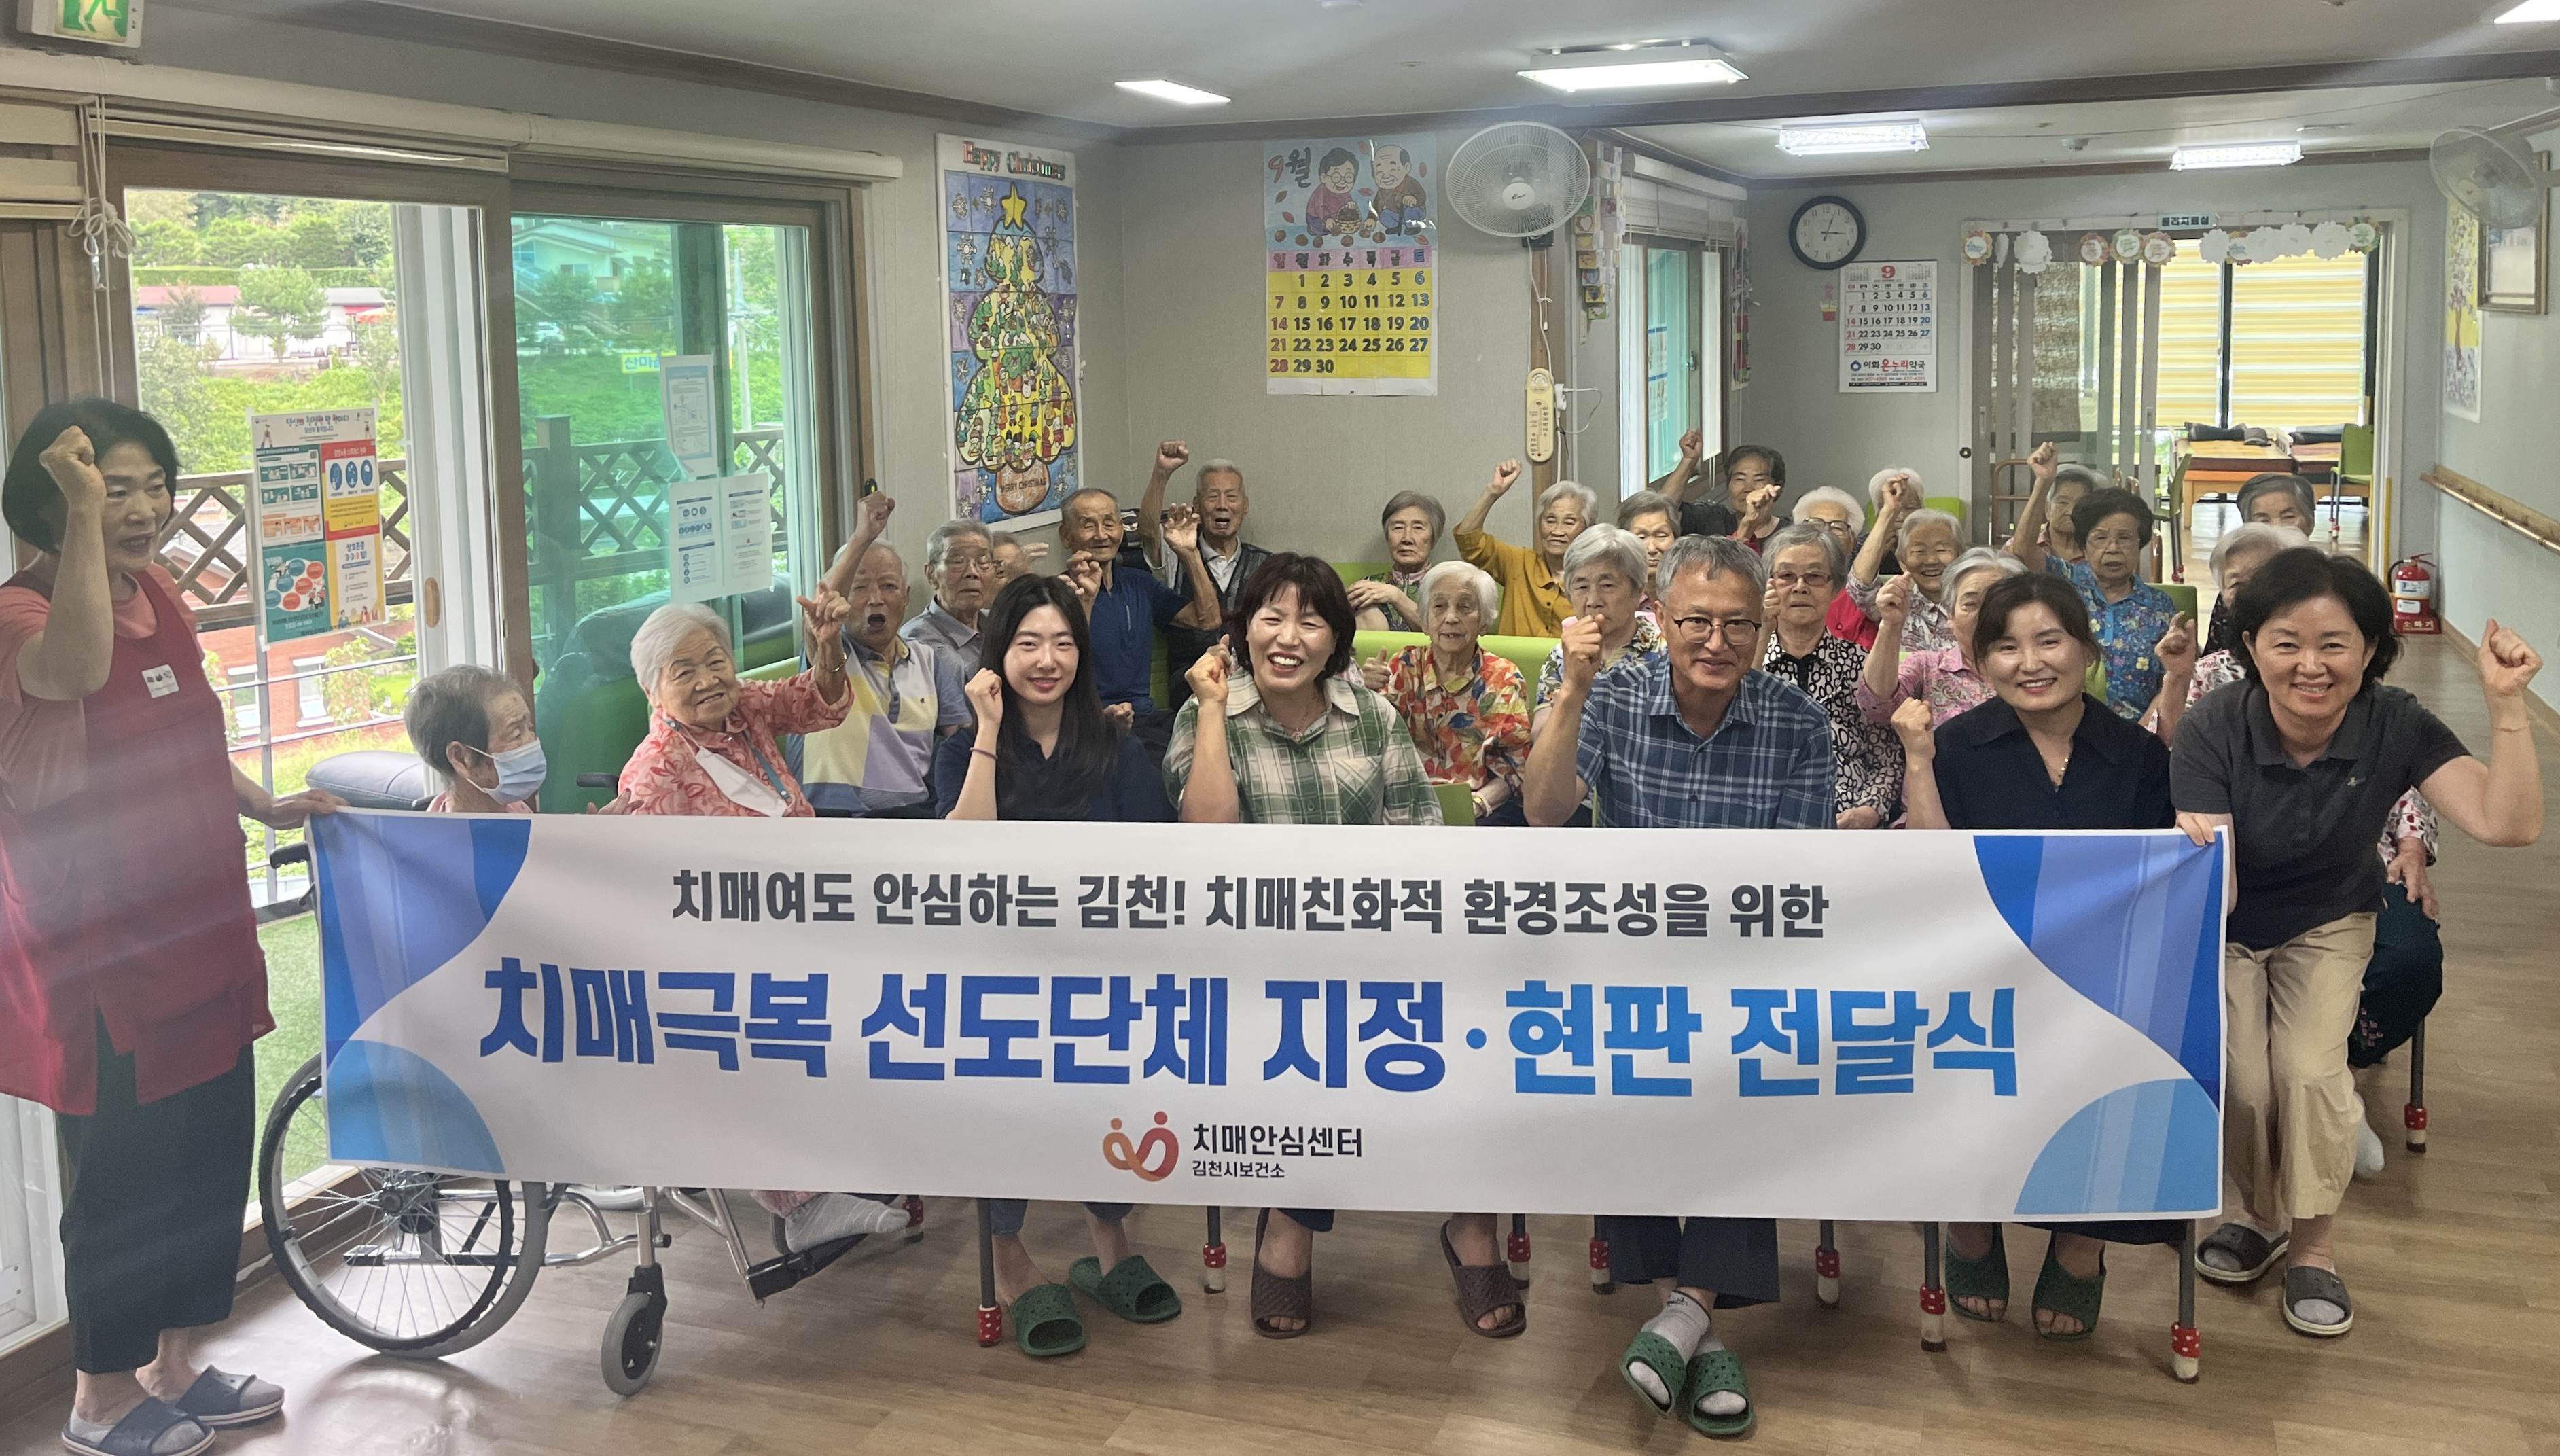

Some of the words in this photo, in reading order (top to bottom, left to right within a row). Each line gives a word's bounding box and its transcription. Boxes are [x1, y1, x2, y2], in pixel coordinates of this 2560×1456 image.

[963, 141, 1001, 173] Happy
[1268, 147, 1311, 188] 9월
[1274, 253, 1285, 269] 일
[1319, 253, 1331, 266] 화
[1343, 252, 1353, 266] 수
[1391, 250, 1400, 266] 금
[1414, 249, 1425, 262] 토
[1299, 274, 1304, 287] 1
[1321, 274, 1329, 287] 2
[1344, 274, 1353, 287] 3
[1367, 273, 1376, 285] 4
[1391, 272, 1400, 285] 5
[1415, 271, 1425, 285] 6
[1881, 266, 1896, 279] 9
[1275, 296, 1284, 309] 7
[1298, 296, 1306, 309] 8
[1321, 296, 1330, 308] 9
[1340, 296, 1357, 308] 10
[1364, 295, 1378, 308] 11
[1388, 294, 1405, 307] 12
[1411, 293, 1429, 306] 13
[1272, 317, 1288, 330] 14
[1294, 317, 1310, 330] 15
[1317, 317, 1333, 330] 16
[1340, 317, 1356, 330] 17
[1364, 317, 1381, 330] 18
[1387, 317, 1404, 330] 19
[1410, 317, 1429, 330] 20
[1920, 317, 1930, 325] 20
[1271, 338, 1286, 351] 21
[1293, 338, 1311, 351] 22
[1316, 338, 1334, 352] 23
[1339, 338, 1357, 351] 24
[1362, 338, 1381, 352] 25
[1386, 338, 1404, 351] 26
[1410, 338, 1428, 351] 27
[1270, 359, 1288, 372] 28
[1294, 359, 1311, 372] 29
[1316, 359, 1334, 373] 30
[1001, 482, 1017, 493] MERRY
[1020, 478, 1046, 489] CHRISTMAS
[673, 870, 855, 923] 치매여도
[874, 873, 1058, 927] 안심하는
[1078, 875, 1185, 929] 김천!
[1206, 876, 1442, 934] 치매친화적
[1465, 879, 1709, 937] 환경조성을
[1730, 884, 1829, 938] 위한
[480, 957, 831, 1078] 치매극복
[861, 974, 1228, 1086] 선도단체
[1731, 987, 2018, 1097] 전달식
[1194, 1124, 1362, 1157] 치매안심센터
[1193, 1161, 1285, 1178] 김천시보건소
